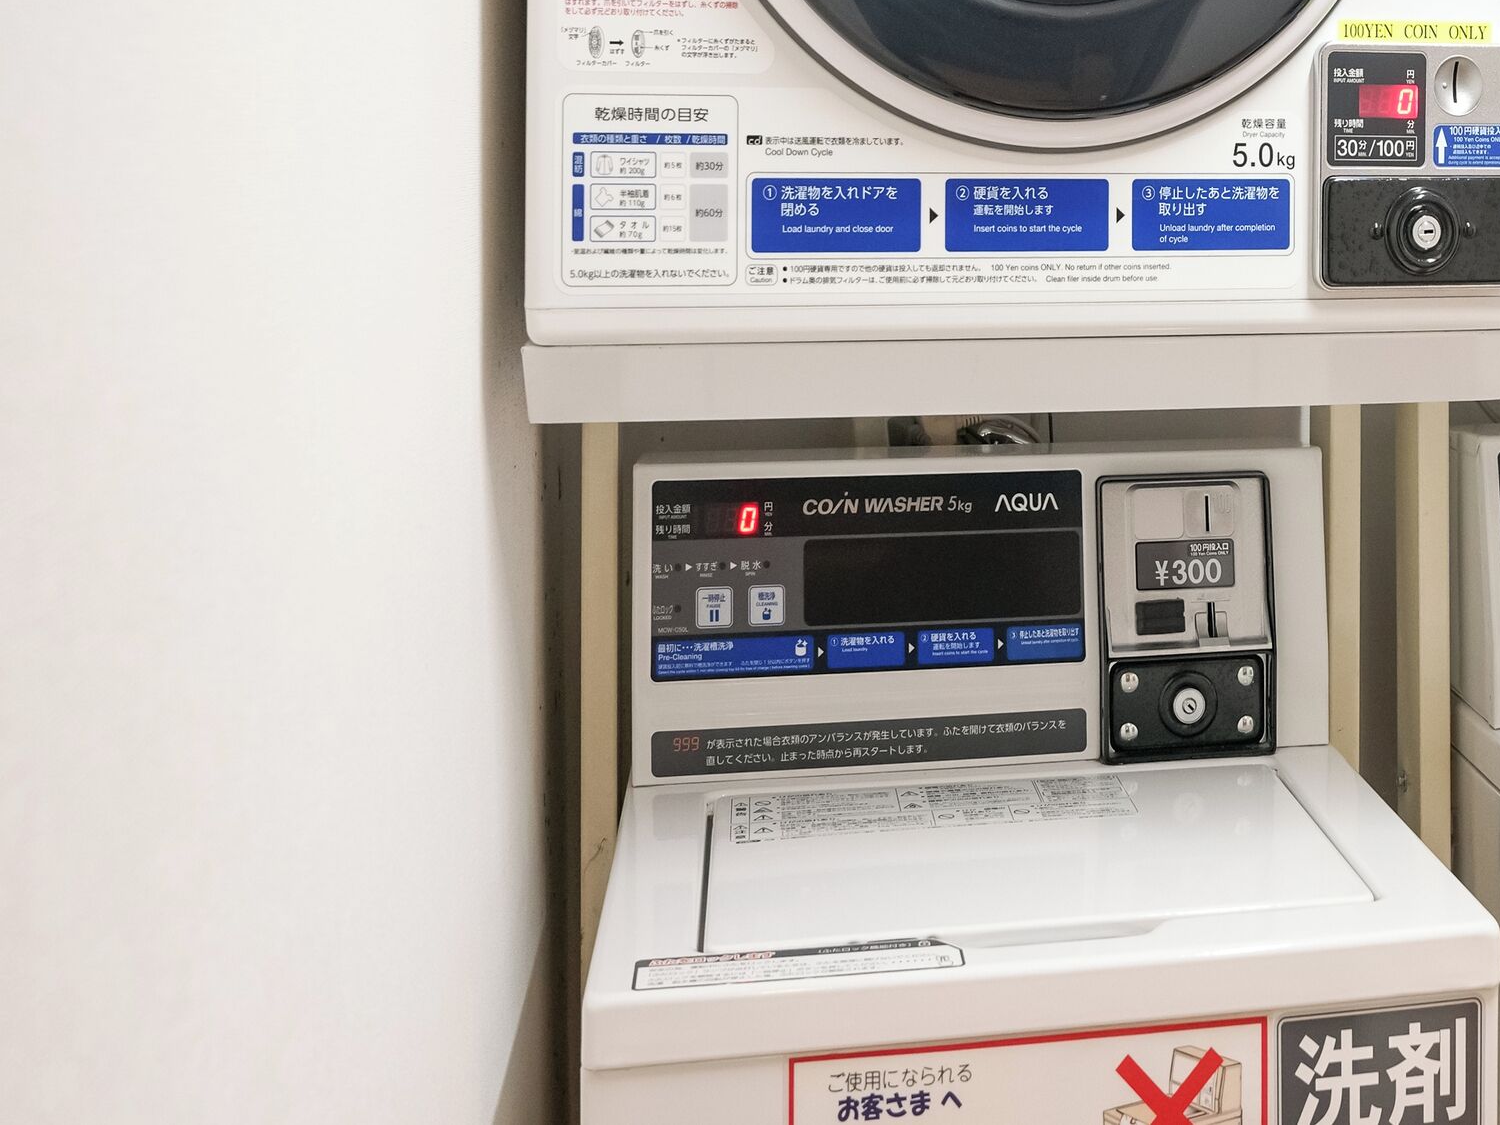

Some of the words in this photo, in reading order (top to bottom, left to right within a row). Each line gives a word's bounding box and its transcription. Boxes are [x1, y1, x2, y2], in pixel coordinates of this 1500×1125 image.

[1344, 23, 1393, 38] 100YEN
[1404, 24, 1438, 39] COIN
[1449, 25, 1487, 39] ONLY
[1334, 68, 1363, 77] 投入金額
[1407, 70, 1414, 79] 円
[1397, 89, 1413, 115] 0
[595, 107, 708, 122] 乾燥時間の目安
[1241, 119, 1286, 129] 乾燥容量
[1334, 119, 1363, 128] 残り時間
[1407, 120, 1414, 128] 分
[765, 148, 783, 156] Cool
[811, 149, 833, 157] Cycle
[620, 158, 649, 166] ワイシャツ
[696, 162, 723, 171] 約30分
[781, 186, 897, 200] 洗濯物を入れドアを
[974, 187, 1048, 200] 硬貨を入れる
[1159, 186, 1279, 200] 停止したあと洗濯物を
[695, 209, 722, 217] 約60分
[781, 203, 820, 216] 閉める
[974, 205, 1054, 216] 運転を開始します
[1159, 203, 1207, 216] 取り出す
[782, 225, 801, 233] Load
[804, 225, 833, 234] laundry
[836, 225, 850, 233] and
[853, 225, 872, 233] close
[876, 225, 893, 233] door
[1062, 225, 1082, 233] cycle
[1160, 224, 1185, 232] Unload
[1188, 224, 1215, 233] laundry
[1217, 224, 1233, 232] after
[1235, 224, 1275, 233] completion
[1160, 235, 1167, 243] of
[1170, 236, 1188, 244] cycle
[749, 267, 774, 275] ご注意
[803, 492, 859, 515] COIN
[865, 496, 943, 512] WASHER
[948, 496, 972, 513] 5kg
[995, 493, 1059, 512] AQUA
[656, 505, 691, 514] 投入金額
[765, 503, 773, 512] 円
[739, 506, 757, 533] 0
[656, 525, 690, 534] 残り時間
[764, 523, 773, 531] 分
[696, 562, 717, 571] すすぎ
[1155, 559, 1221, 585] ¥300
[841, 636, 894, 646] 洗濯物を入れる
[931, 633, 976, 642] 硬貨を入れる
[658, 653, 702, 661] Pre-Cleaning
[673, 736, 699, 752] 999
[1295, 1018, 1466, 1125] 洗剤
[828, 1064, 972, 1093] ご使用になられる
[838, 1091, 931, 1121] お客さま
[941, 1093, 962, 1107] へ
